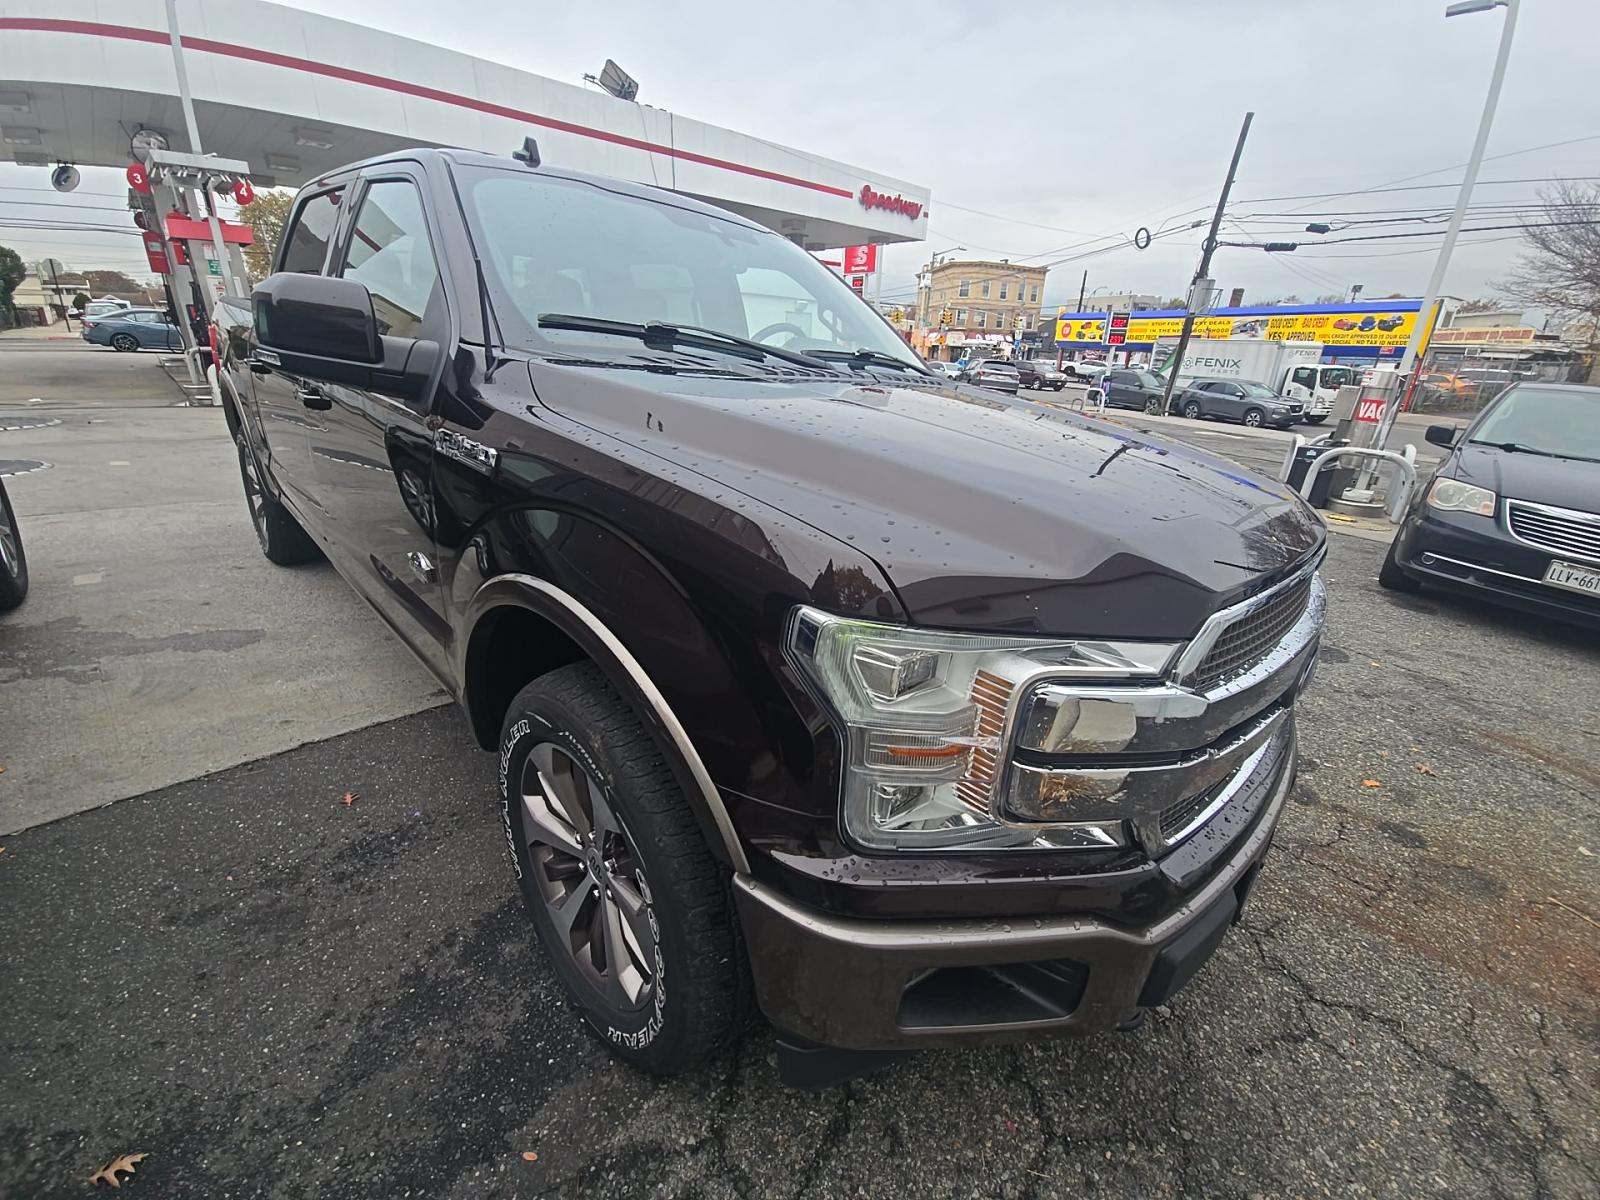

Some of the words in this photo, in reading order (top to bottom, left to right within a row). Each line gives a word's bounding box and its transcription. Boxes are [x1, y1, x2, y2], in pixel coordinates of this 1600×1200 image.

[133, 173, 142, 184] 3
[239, 187, 248, 197] 4
[859, 184, 923, 220] Speedway
[1268, 331, 1285, 341] YES!
[1286, 331, 1316, 341] APPROVED
[1194, 357, 1242, 369] FENIX
